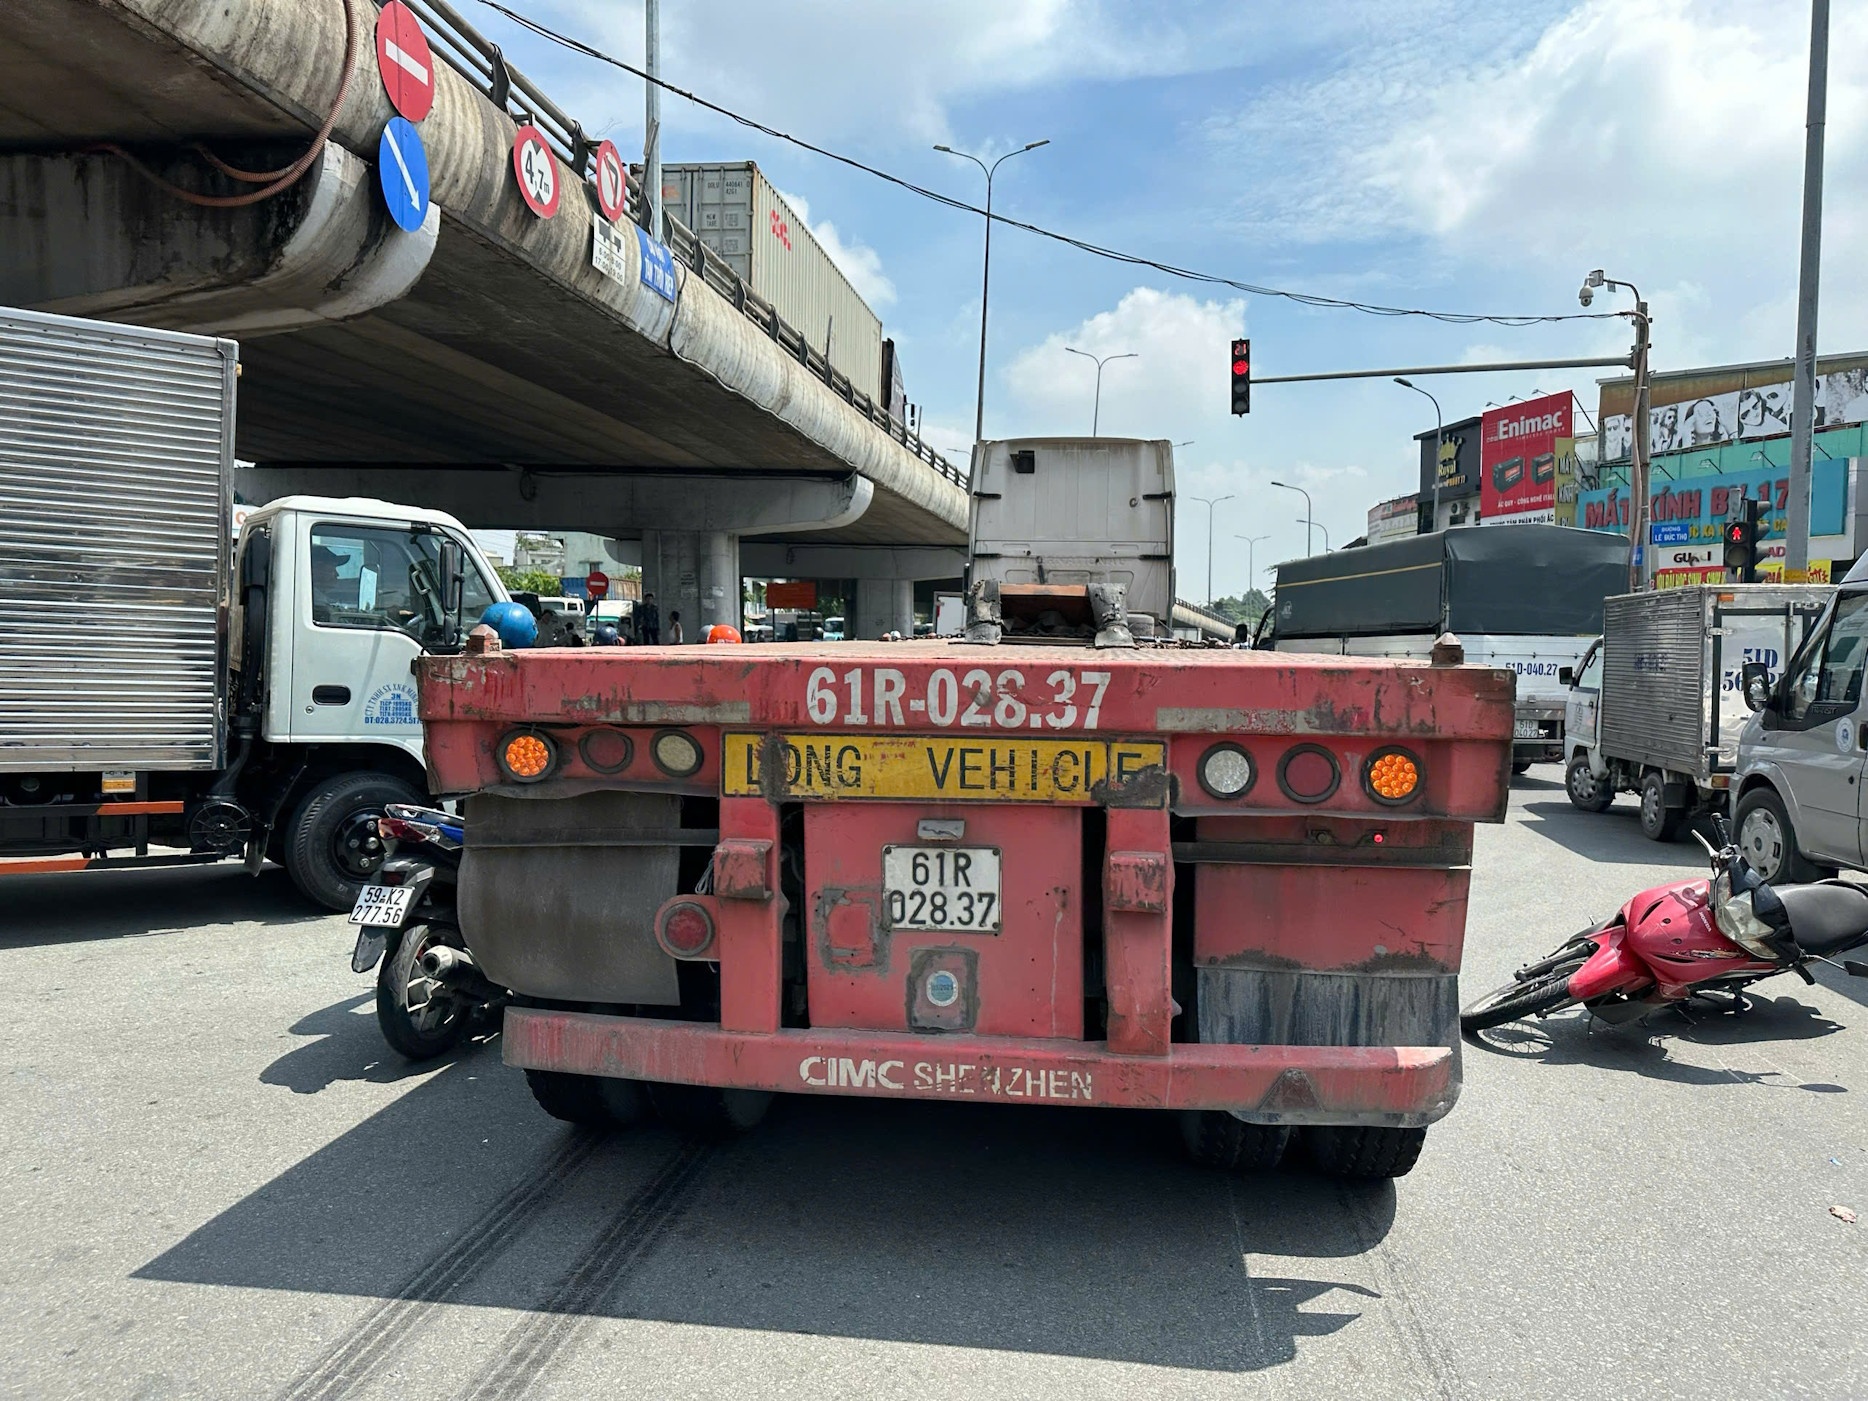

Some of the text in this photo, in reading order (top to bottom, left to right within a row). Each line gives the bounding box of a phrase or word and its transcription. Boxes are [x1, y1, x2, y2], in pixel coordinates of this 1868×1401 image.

[1497, 411, 1563, 440] Enimac
[1438, 459, 1457, 478] Royal
[1742, 648, 1778, 668] 51D
[806, 666, 1111, 729] 61R-028.37
[912, 852, 971, 887] 61R
[352, 905, 402, 924] 277.56
[889, 889, 996, 928] 028.37
[800, 1056, 904, 1090] CIMC
